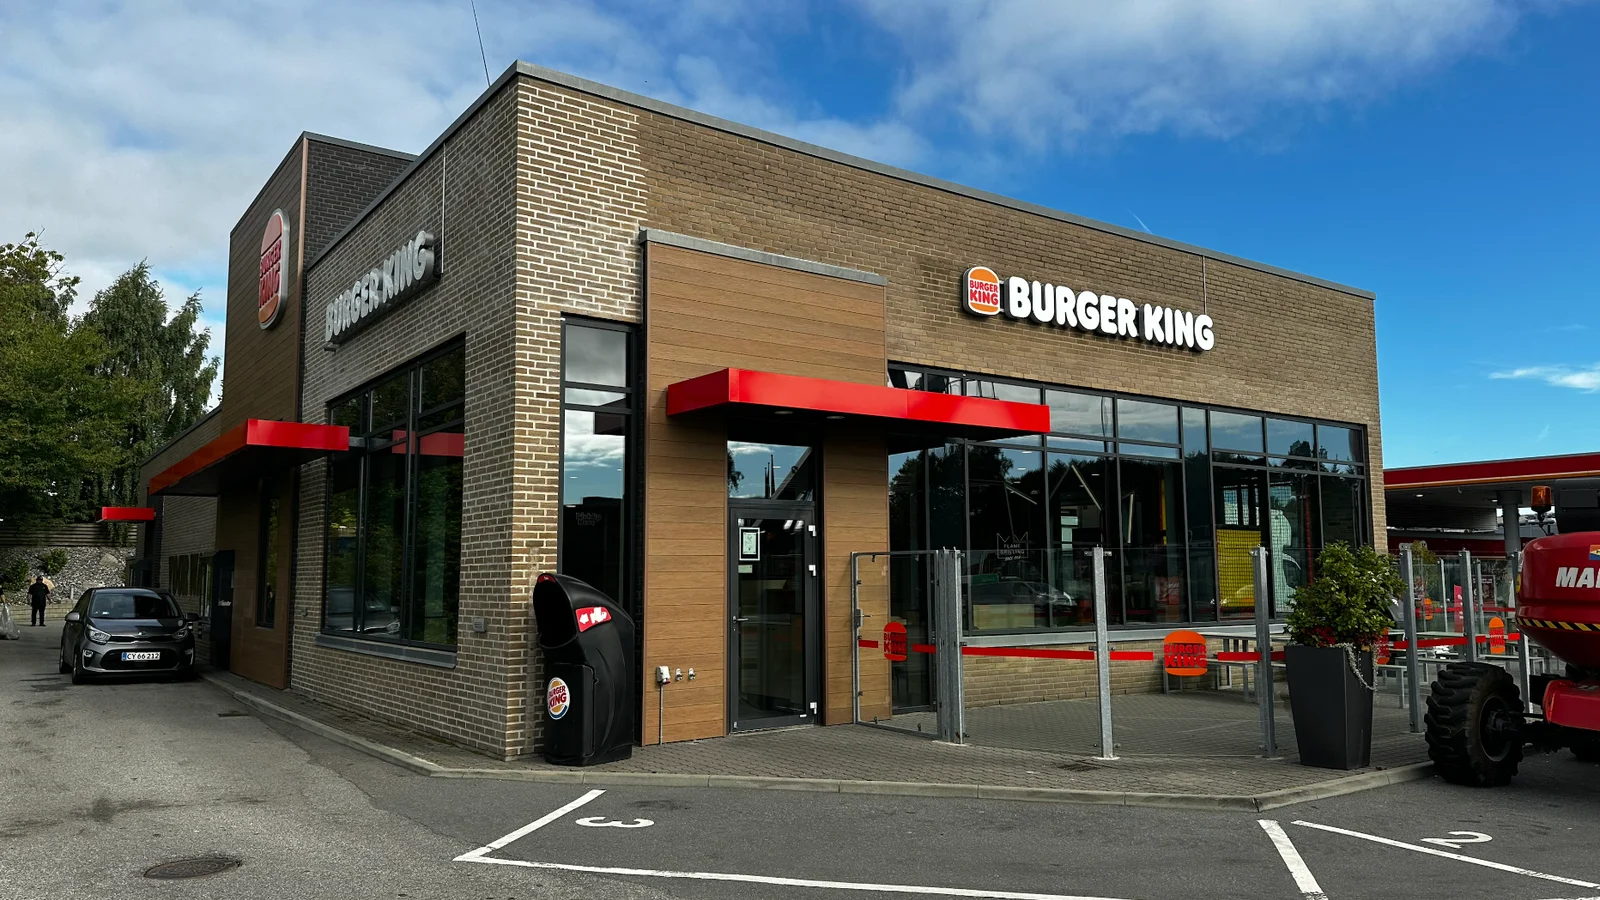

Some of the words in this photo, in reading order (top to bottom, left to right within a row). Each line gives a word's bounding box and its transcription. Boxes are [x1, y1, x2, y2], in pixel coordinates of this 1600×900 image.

[325, 267, 379, 342] BURGER
[382, 230, 430, 304] KING
[970, 280, 998, 293] BURGER
[970, 289, 998, 305] KING
[1008, 275, 1138, 338] BURGER
[1143, 303, 1215, 351] KING
[1164, 643, 1207, 654] BURGER
[1164, 653, 1208, 668] KING
[549, 692, 567, 709] KING
[575, 816, 655, 828] 3
[1420, 831, 1493, 848] 2
